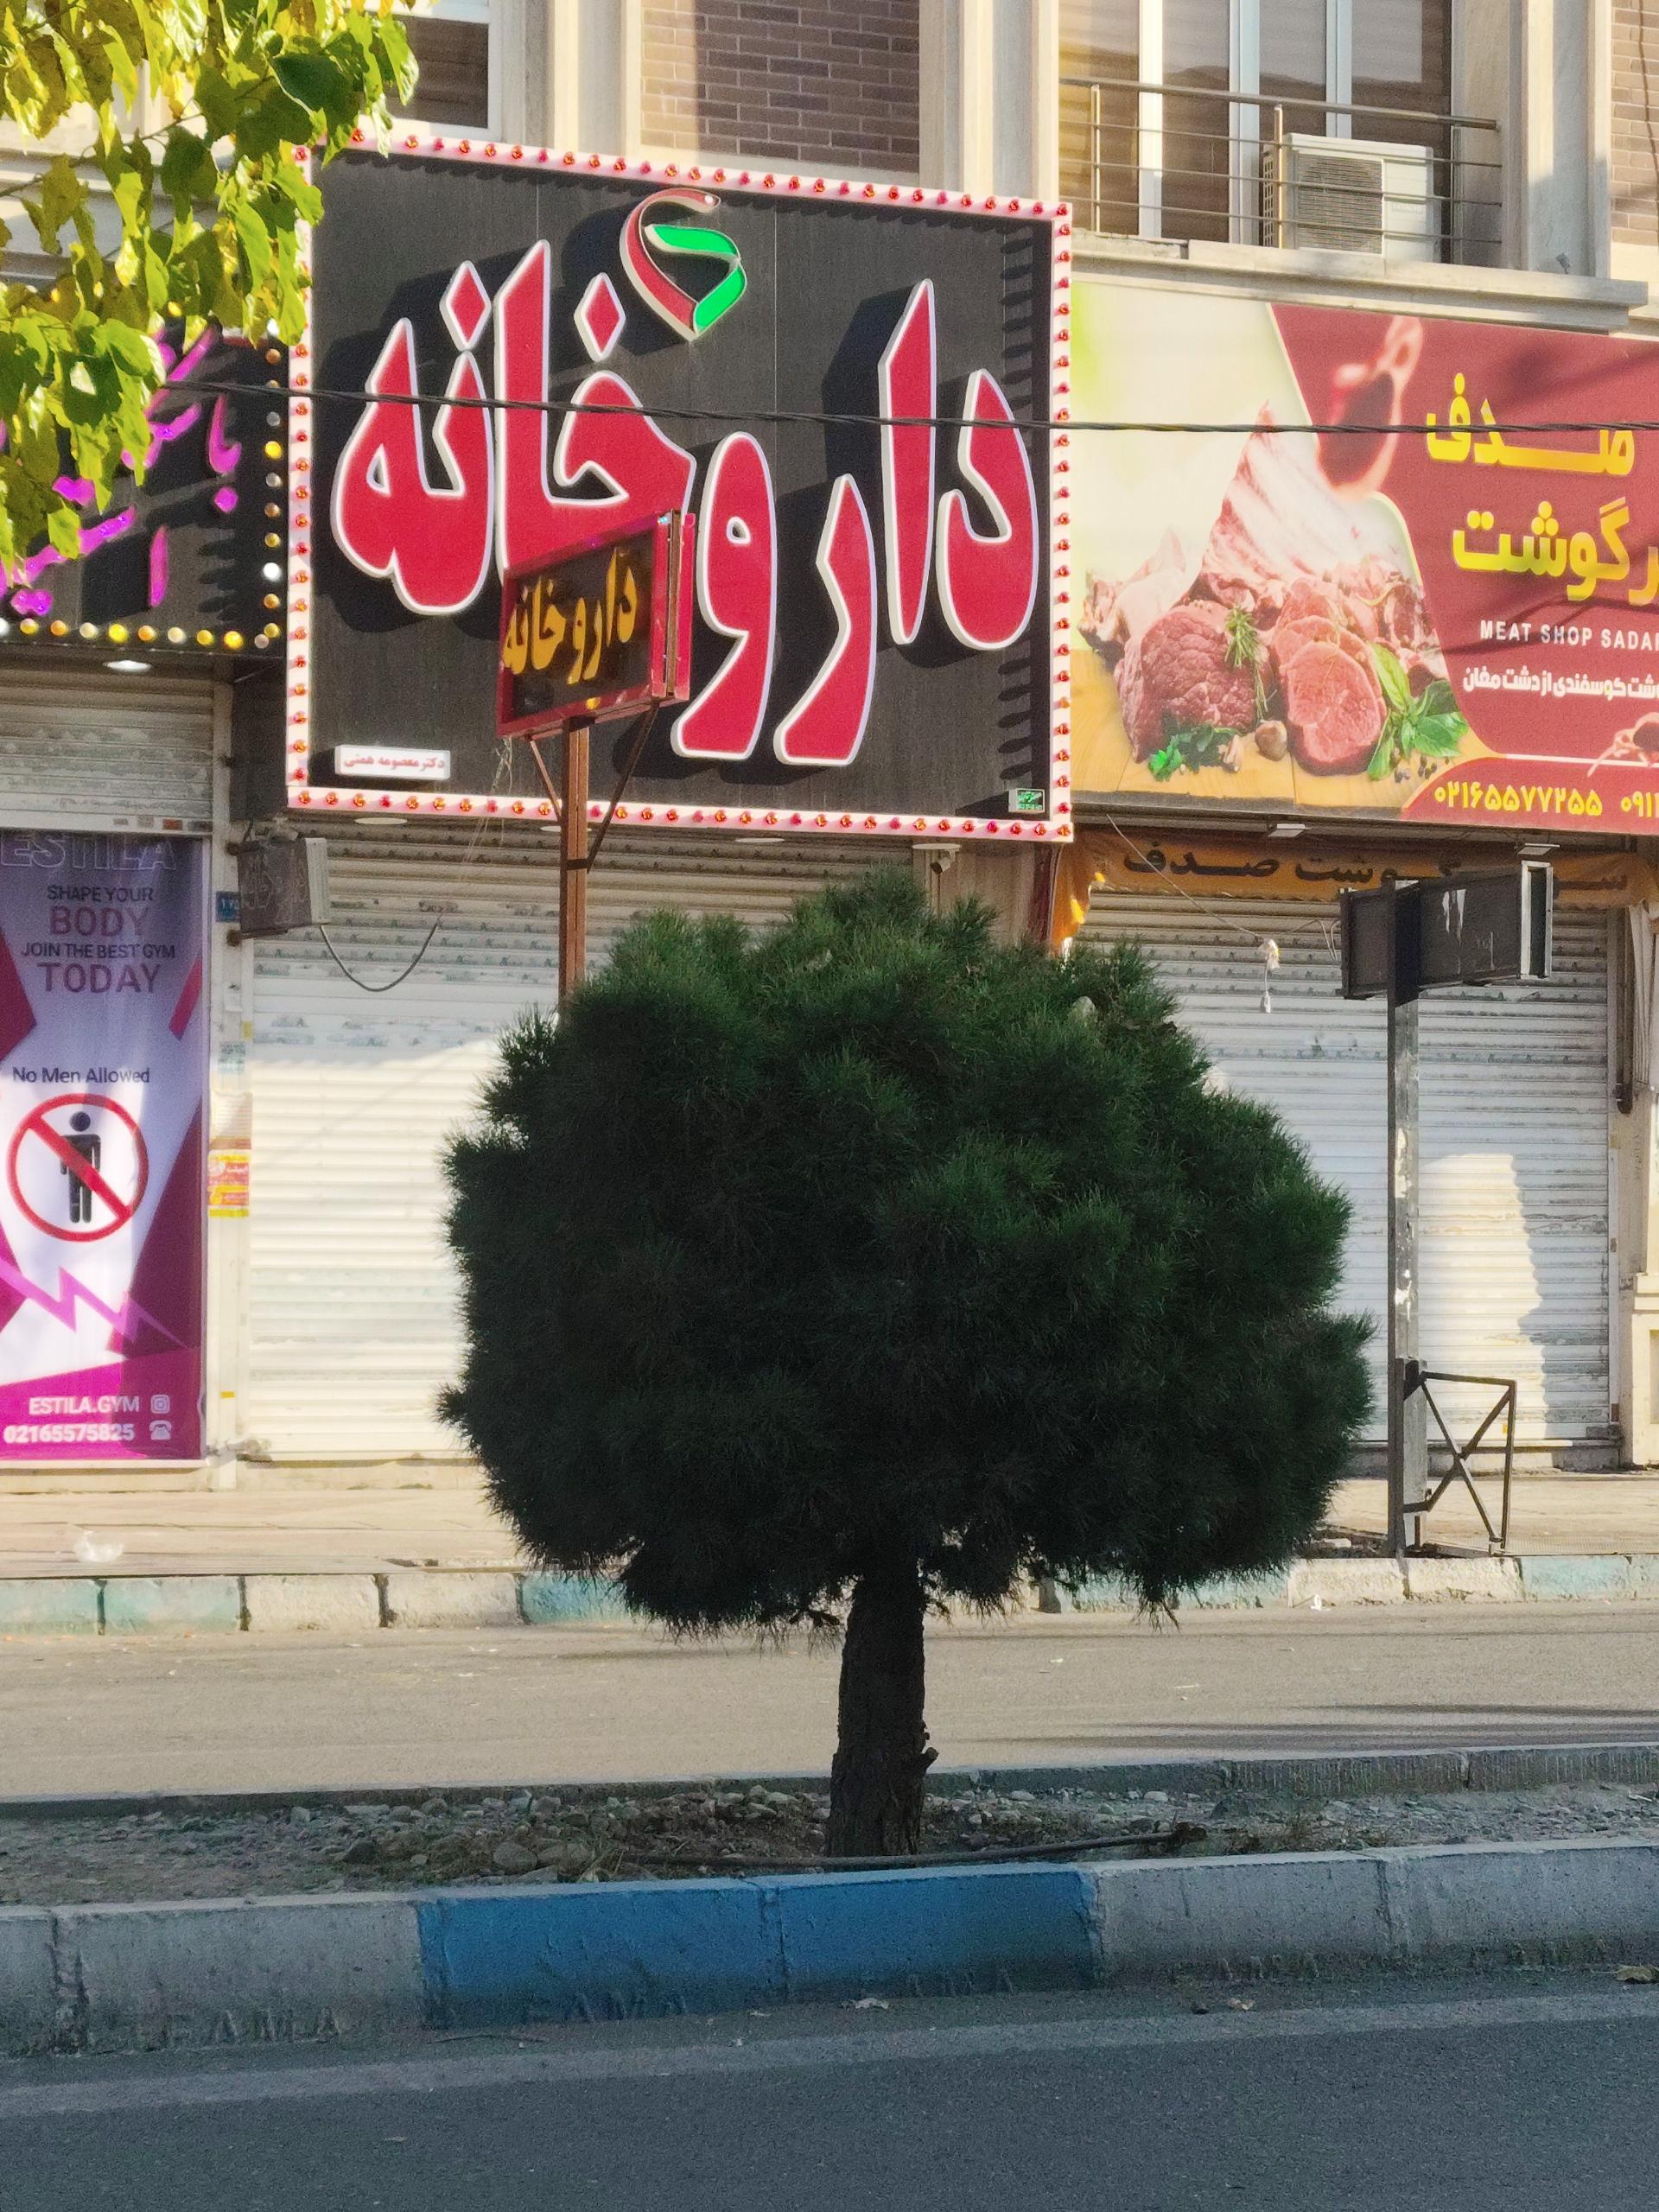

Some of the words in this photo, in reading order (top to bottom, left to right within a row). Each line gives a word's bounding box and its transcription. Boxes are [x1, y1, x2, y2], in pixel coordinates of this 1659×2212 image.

[1426, 372, 1636, 475] صدف
[332, 239, 1039, 766] داروخانه
[1452, 496, 1630, 601] گوشت
[503, 547, 638, 685] داروخانه
[1479, 620, 1532, 642] MEAT
[1541, 624, 1592, 647] SHOP
[1462, 664, 1502, 692] مغان
[1503, 664, 1541, 692] دشت
[1541, 670, 1552, 696] از
[1433, 780, 1603, 817] ۰۲۱۶۵۵۷۷۲۵۵
[47, 884, 102, 902] SHAPE
[103, 887, 154, 903] YOUR
[49, 906, 149, 937] BODY
[21, 941, 61, 957] JOIN
[65, 943, 93, 959] THE
[97, 944, 140, 959] BEST
[143, 944, 176, 960] GYM
[37, 962, 162, 994] TODAY
[12, 1066, 37, 1084] No
[42, 1066, 81, 1084] Men
[85, 1066, 150, 1084] Allowed
[29, 1395, 140, 1416] ESTILA.GYM
[3, 1423, 136, 1444] 02165575825
